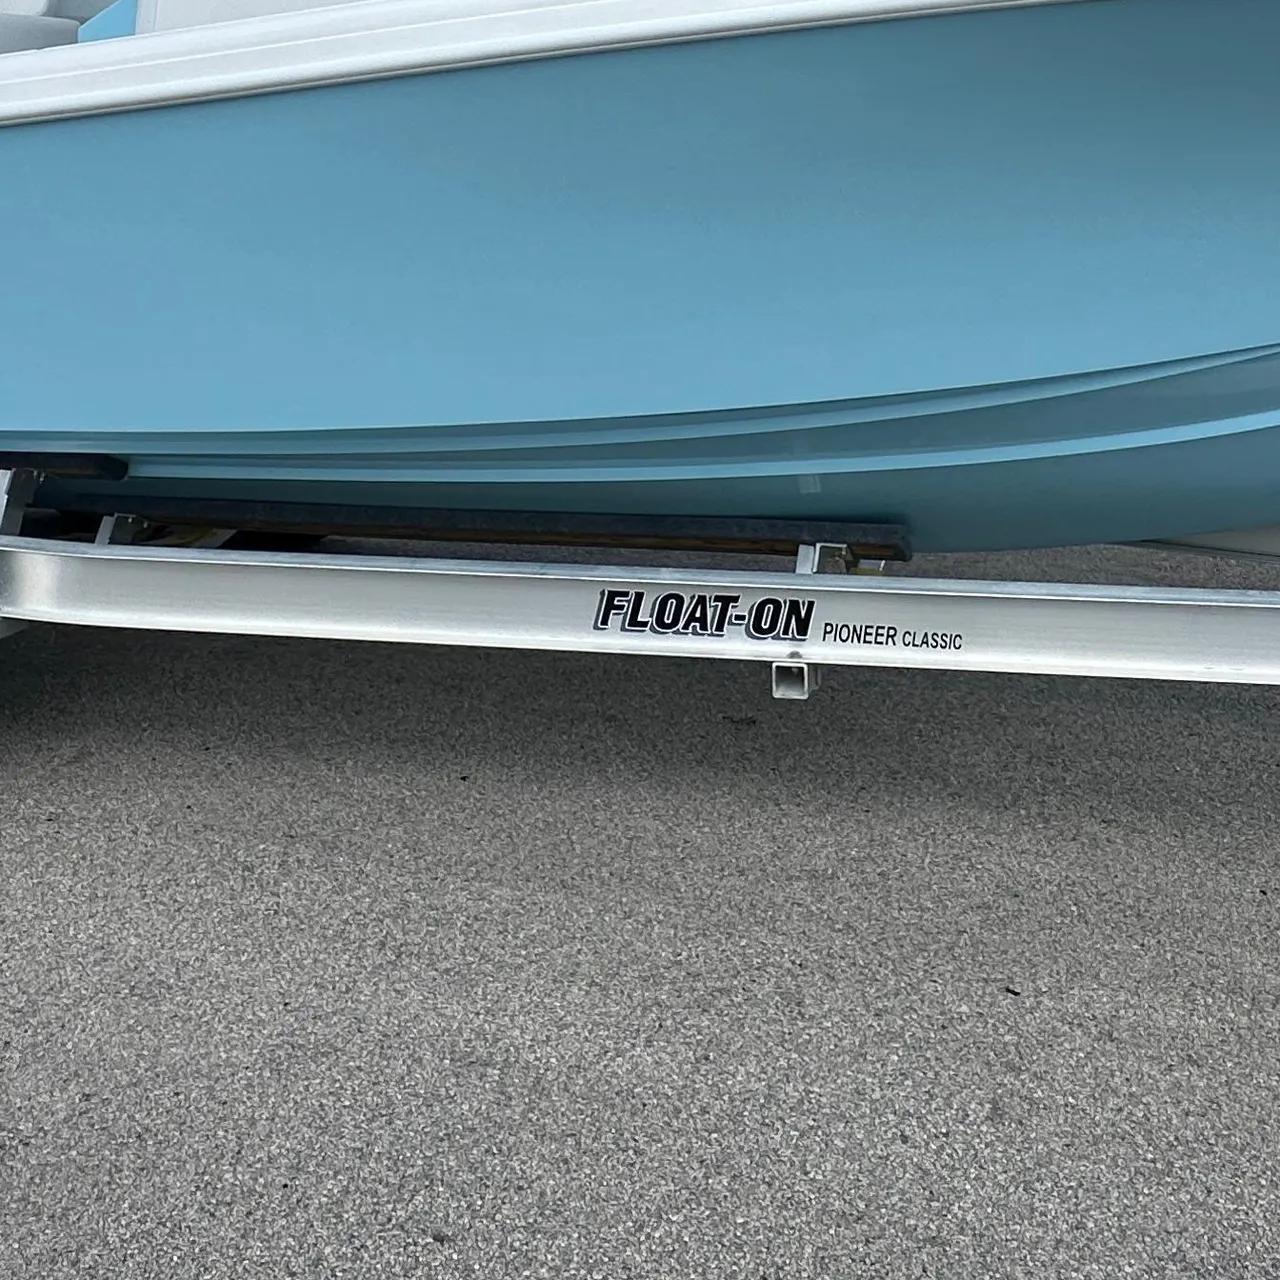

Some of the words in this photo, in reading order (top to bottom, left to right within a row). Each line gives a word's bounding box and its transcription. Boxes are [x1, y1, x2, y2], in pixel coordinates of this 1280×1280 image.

[593, 589, 816, 642] FLOAT-ON
[822, 622, 899, 647] PIONEER
[901, 630, 963, 650] CLASSIC
